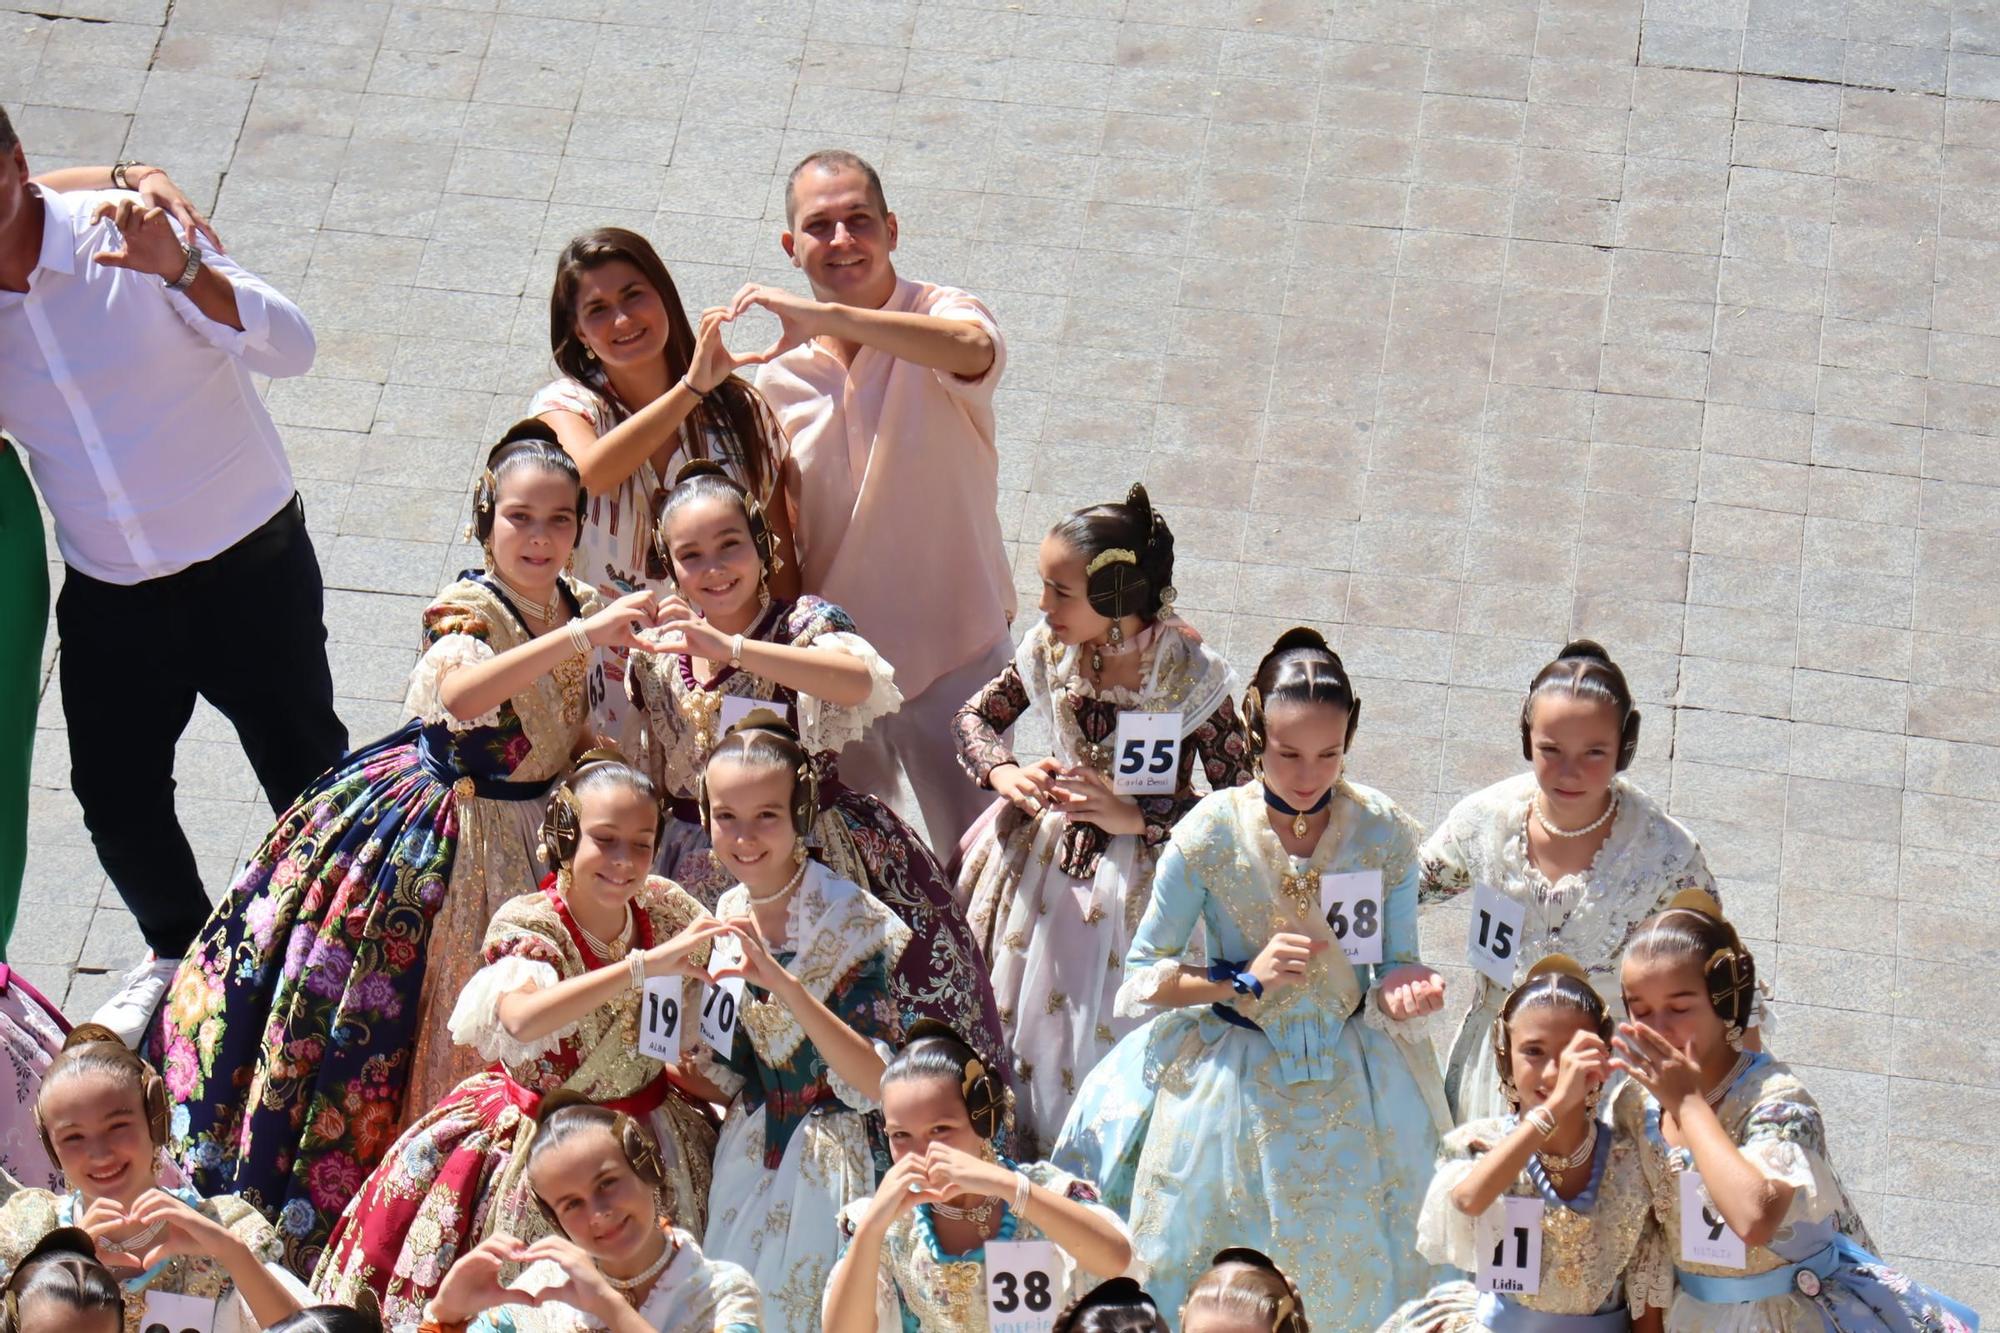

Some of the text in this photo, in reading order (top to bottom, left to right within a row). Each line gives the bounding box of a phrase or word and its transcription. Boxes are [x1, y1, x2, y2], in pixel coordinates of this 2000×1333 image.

[589, 663, 605, 712] 63
[1119, 739, 1174, 774] 55
[1326, 899, 1378, 938] 68
[1479, 909, 1514, 959] 15
[649, 992, 678, 1038] 19
[703, 983, 734, 1033] 70
[648, 1041, 667, 1055] ALBA
[992, 1271, 1052, 1314] 38
[1492, 1278, 1524, 1291] Lidia
